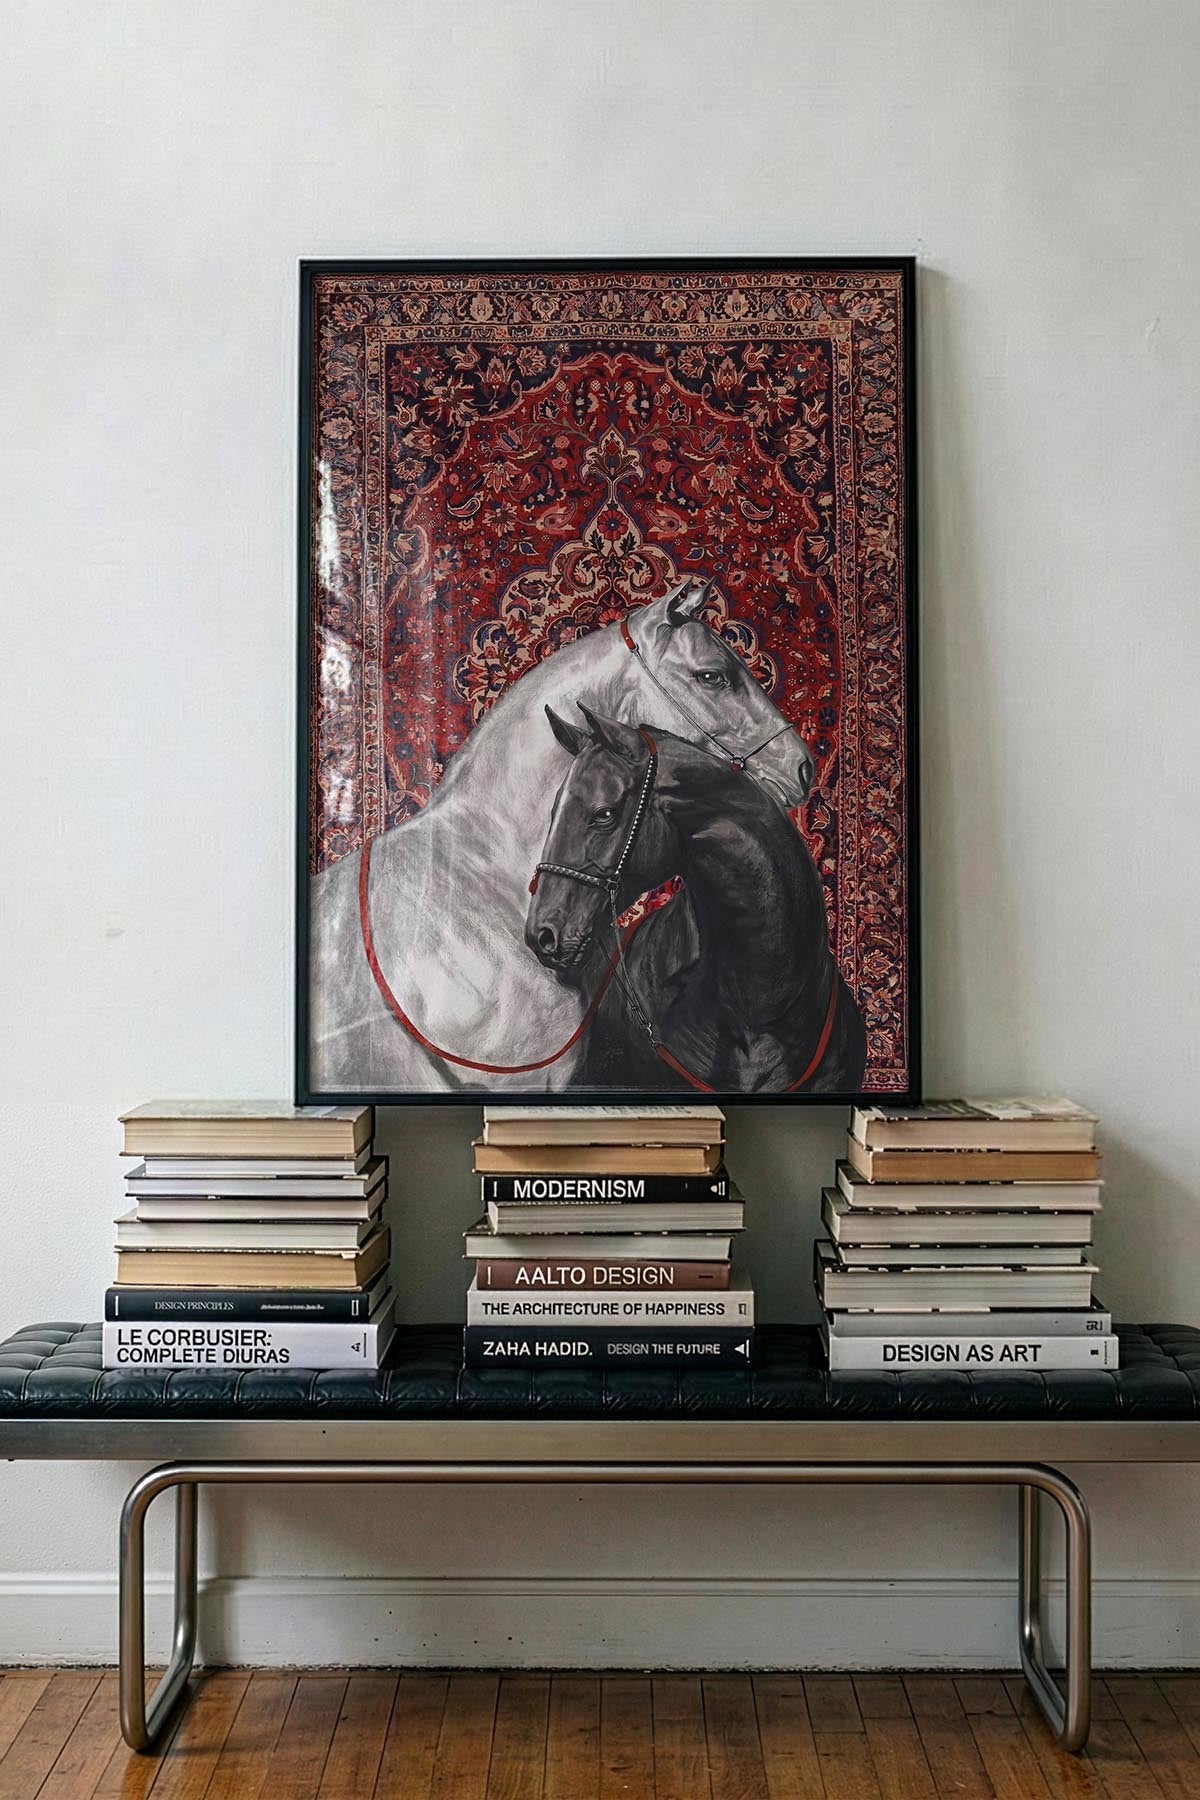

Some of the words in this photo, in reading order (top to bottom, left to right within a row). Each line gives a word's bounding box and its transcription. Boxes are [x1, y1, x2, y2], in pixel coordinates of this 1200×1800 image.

[513, 1180, 645, 1198] MODERNISM
[515, 1267, 586, 1285] AALTO
[593, 1267, 674, 1285] DESIGN
[154, 1301, 186, 1310] DESIGN
[187, 1301, 235, 1310] PRINCIPLES
[482, 1302, 509, 1315] THE
[513, 1302, 619, 1316] ARCHITECTURE
[623, 1302, 642, 1316] OF
[646, 1302, 725, 1316] HAPPINESS
[117, 1329, 142, 1346] LE
[147, 1328, 272, 1347] CORBUSIER:
[116, 1348, 216, 1364] COMPLETE
[223, 1348, 290, 1364] DIURAS
[483, 1341, 531, 1356] ZAHA
[535, 1341, 593, 1356] HADID.
[607, 1342, 649, 1355] DESIGN
[652, 1342, 674, 1355] THE
[676, 1342, 721, 1355] FUTURE
[883, 1344, 959, 1362] DESIGN
[965, 1344, 994, 1362] AS
[999, 1344, 1042, 1362] ART
